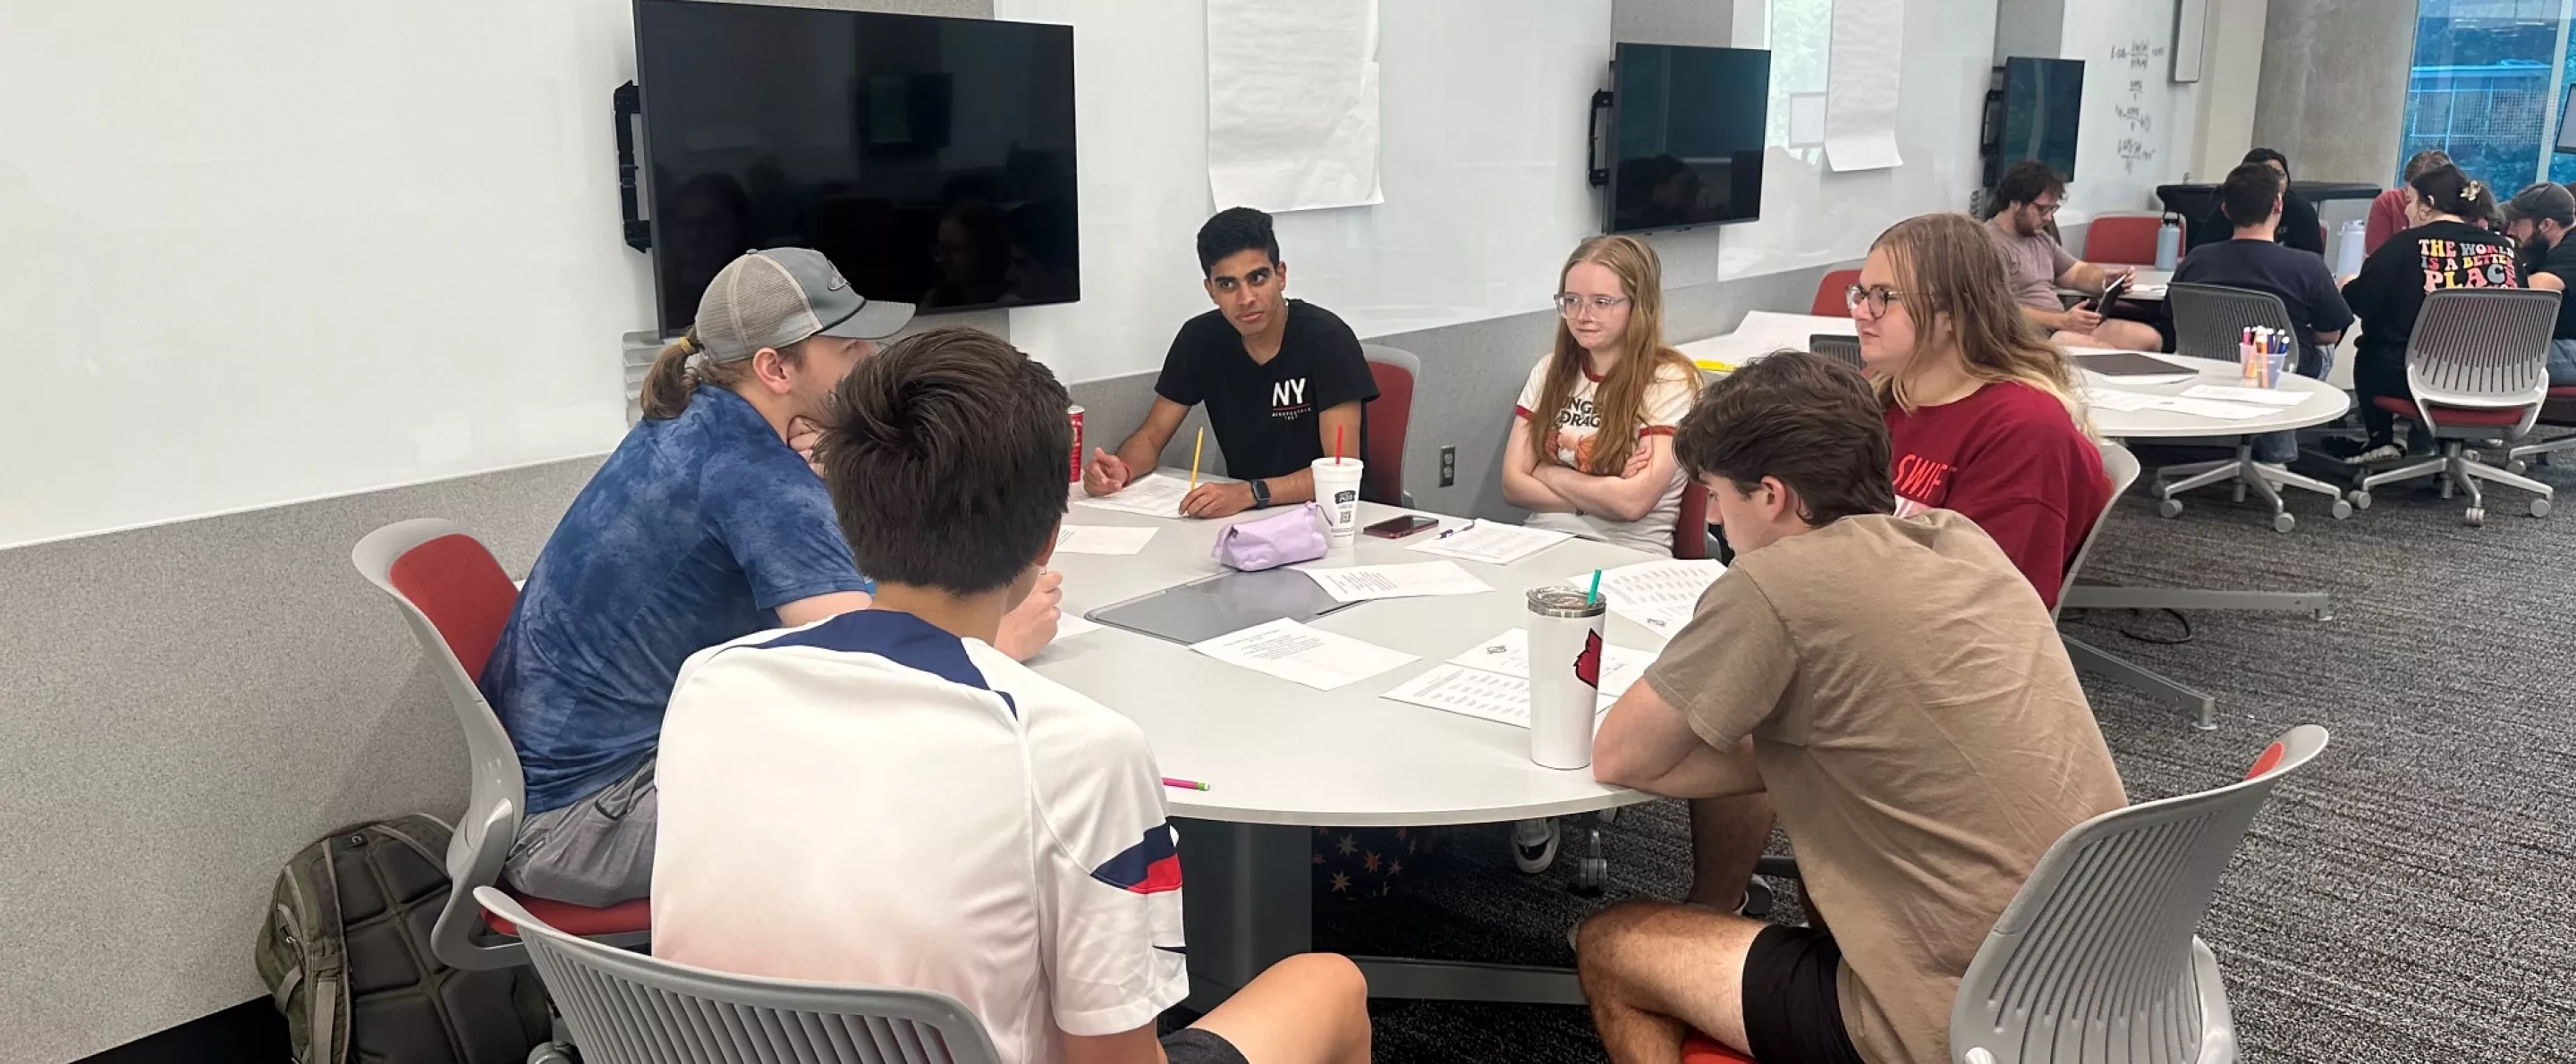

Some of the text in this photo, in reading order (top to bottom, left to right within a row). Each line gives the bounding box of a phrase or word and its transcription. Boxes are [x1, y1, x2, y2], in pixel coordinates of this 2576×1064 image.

[2419, 239, 2514, 258] THE WORLD
[2421, 256, 2440, 270] IS
[2445, 258, 2459, 271] A
[1273, 377, 1306, 407] NY
[1559, 410, 1601, 428] DRAG
